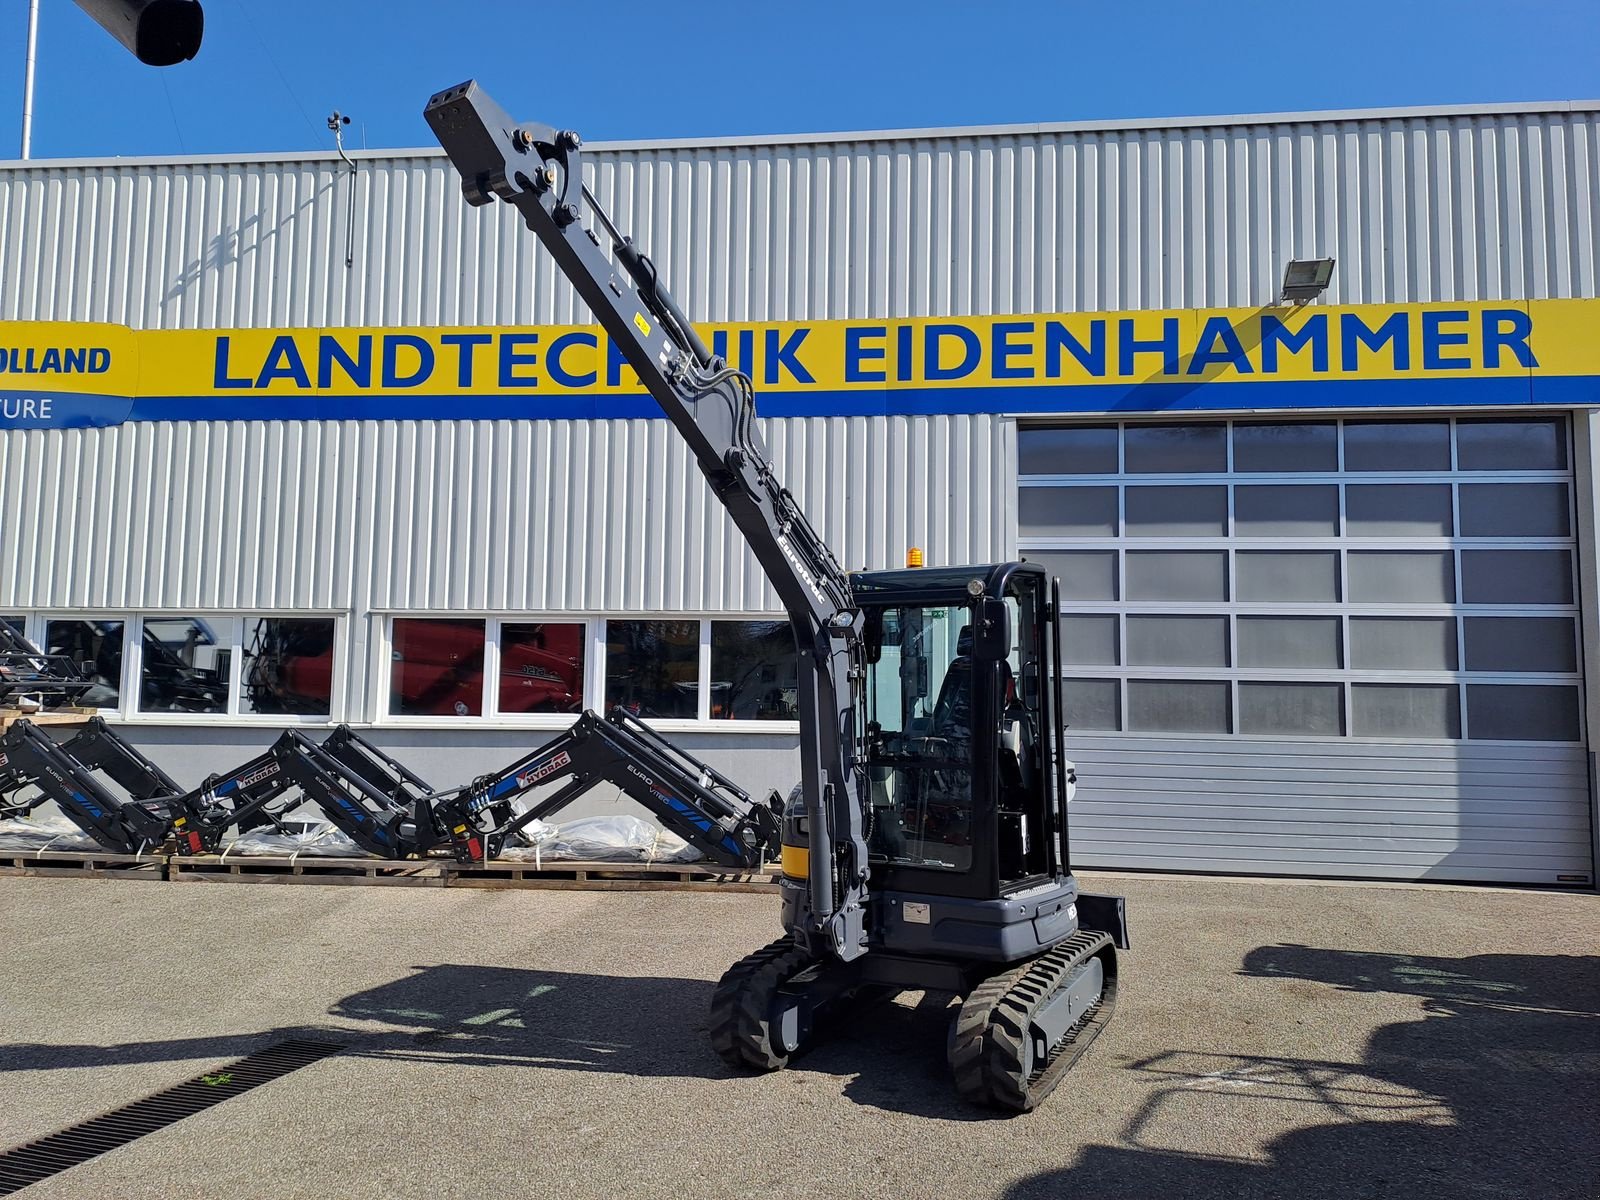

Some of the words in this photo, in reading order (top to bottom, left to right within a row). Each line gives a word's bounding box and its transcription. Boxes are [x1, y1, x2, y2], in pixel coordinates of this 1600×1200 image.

[845, 308, 1540, 384] EIDENHAMMER
[0, 399, 52, 418] URE
[777, 535, 825, 605] Eurotrac
[45, 766, 63, 782] EURO
[244, 766, 279, 785] HYDRAC
[527, 757, 568, 784] HYDRAC
[627, 764, 653, 786] EURO
